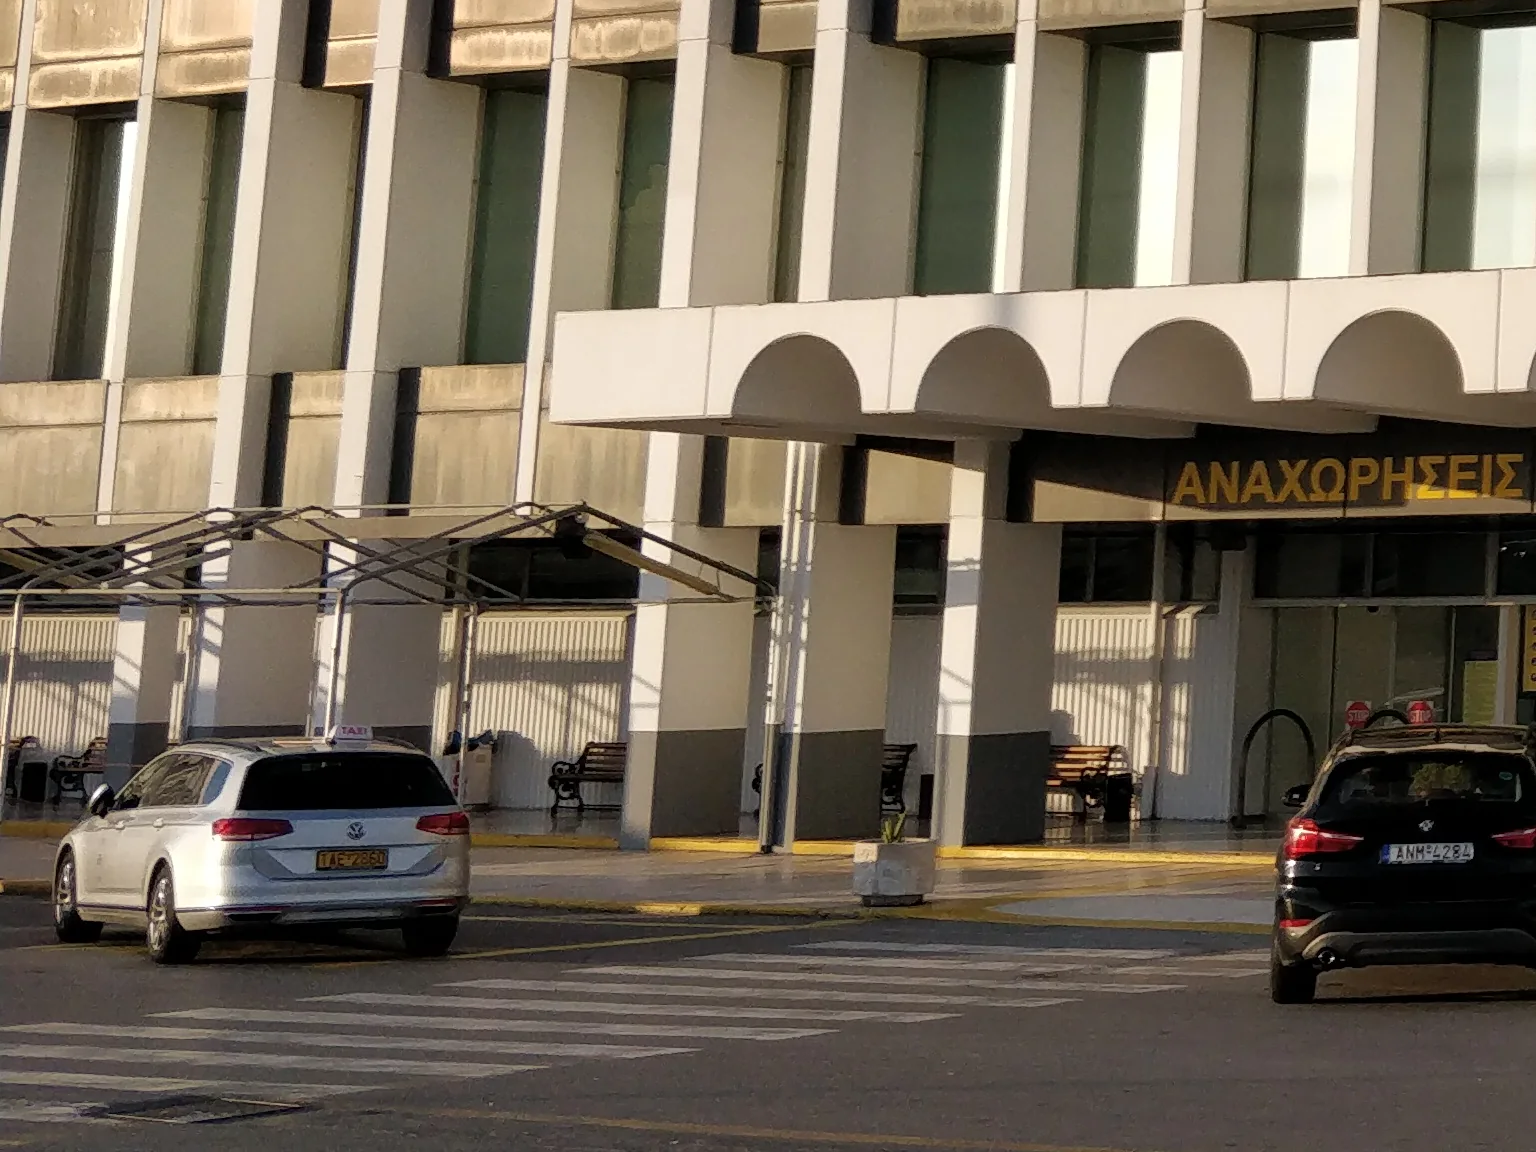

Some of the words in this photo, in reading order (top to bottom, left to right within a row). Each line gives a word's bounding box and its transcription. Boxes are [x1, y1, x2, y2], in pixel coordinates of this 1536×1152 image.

[1173, 453, 1525, 505] ΑΝΑΧΩΡΗΣΕΙΣ
[1348, 709, 1370, 722] STOP
[341, 726, 367, 735] TAXI
